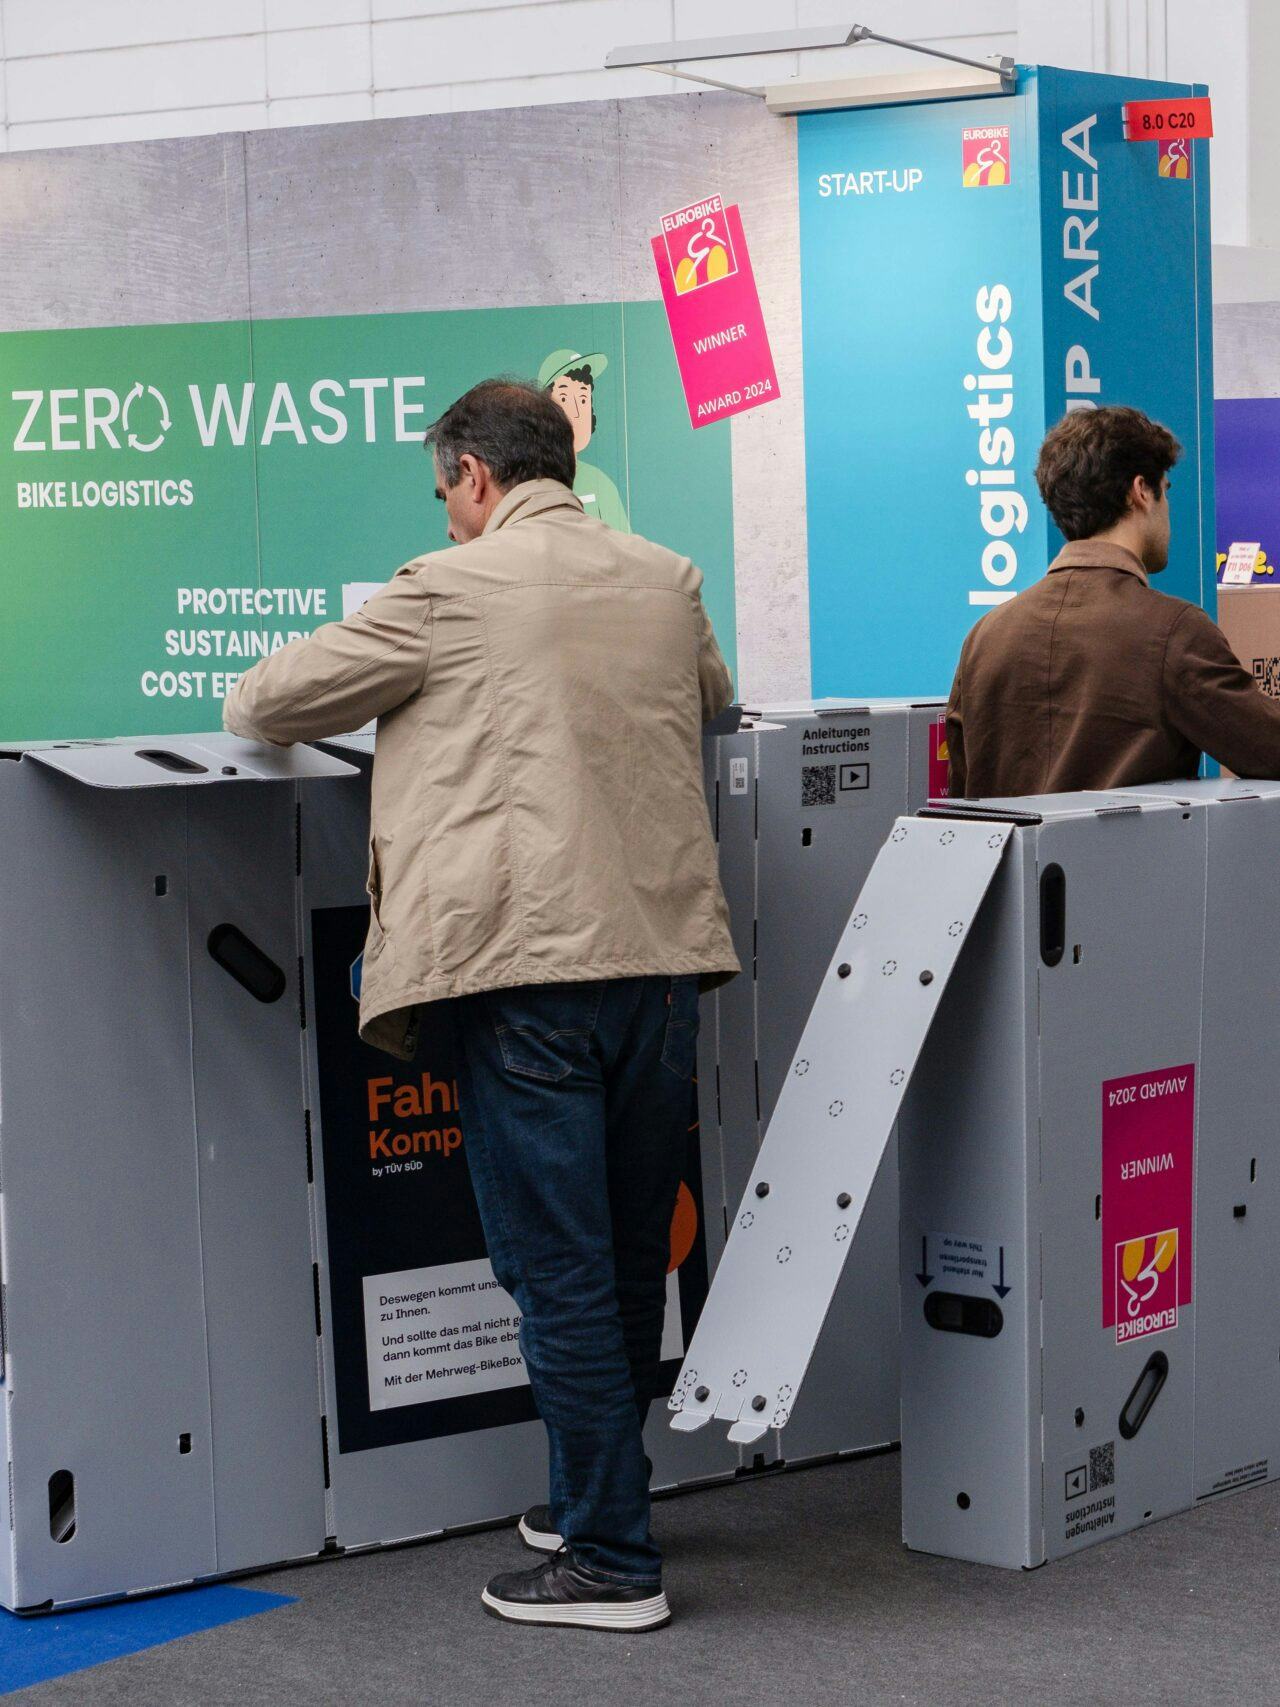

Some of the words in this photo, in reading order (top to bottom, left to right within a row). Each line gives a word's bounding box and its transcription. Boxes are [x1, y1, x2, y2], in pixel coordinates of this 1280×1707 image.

[962, 127, 1009, 141] EUROBIKE
[1142, 113, 1164, 130] 8.0
[1167, 112, 1196, 129] C20
[818, 168, 923, 198] START-UP
[663, 197, 722, 232] EUROBIKE
[1062, 113, 1100, 322] AREA
[693, 323, 748, 354] WINNER
[188, 376, 427, 447] WASTE
[697, 391, 741, 418] AWARD
[744, 378, 773, 400] 2024
[963, 284, 1029, 606] logistics
[17, 481, 67, 508] BIKE
[71, 479, 194, 508] LOGISTICS
[177, 588, 327, 616] PROTECTIVE
[165, 629, 310, 657] SUSTAINA
[141, 671, 207, 698] COST
[803, 727, 871, 740] Anleitungen
[802, 741, 870, 756] Instructions
[1109, 1086, 1137, 1107] 2024
[1140, 1076, 1187, 1100] AWARD
[372, 1167, 383, 1177] by
[385, 1163, 402, 1174] TÜV
[404, 1161, 423, 1172] SÜD
[1120, 1152, 1174, 1180] WINNER
[379, 1290, 436, 1306] Deswegen
[438, 1282, 476, 1297] kommt
[380, 1313, 393, 1321] zu
[395, 1307, 431, 1319] Ihnen.
[1118, 1308, 1175, 1340] EUROBIKE
[382, 1334, 404, 1347] Und
[406, 1329, 437, 1342] sollte
[440, 1327, 459, 1338] das
[462, 1321, 482, 1334] mal
[484, 1317, 510, 1330] nicht
[383, 1351, 411, 1362] dann
[413, 1343, 451, 1357] kommt
[453, 1340, 473, 1351] das
[475, 1335, 498, 1347] Bike
[384, 1376, 402, 1387] Mit
[405, 1372, 423, 1383] der
[426, 1356, 522, 1380] Mehrweg-BikeBox
[1066, 1495, 1115, 1523] Instructions
[1066, 1512, 1115, 1539] Anleitungen
